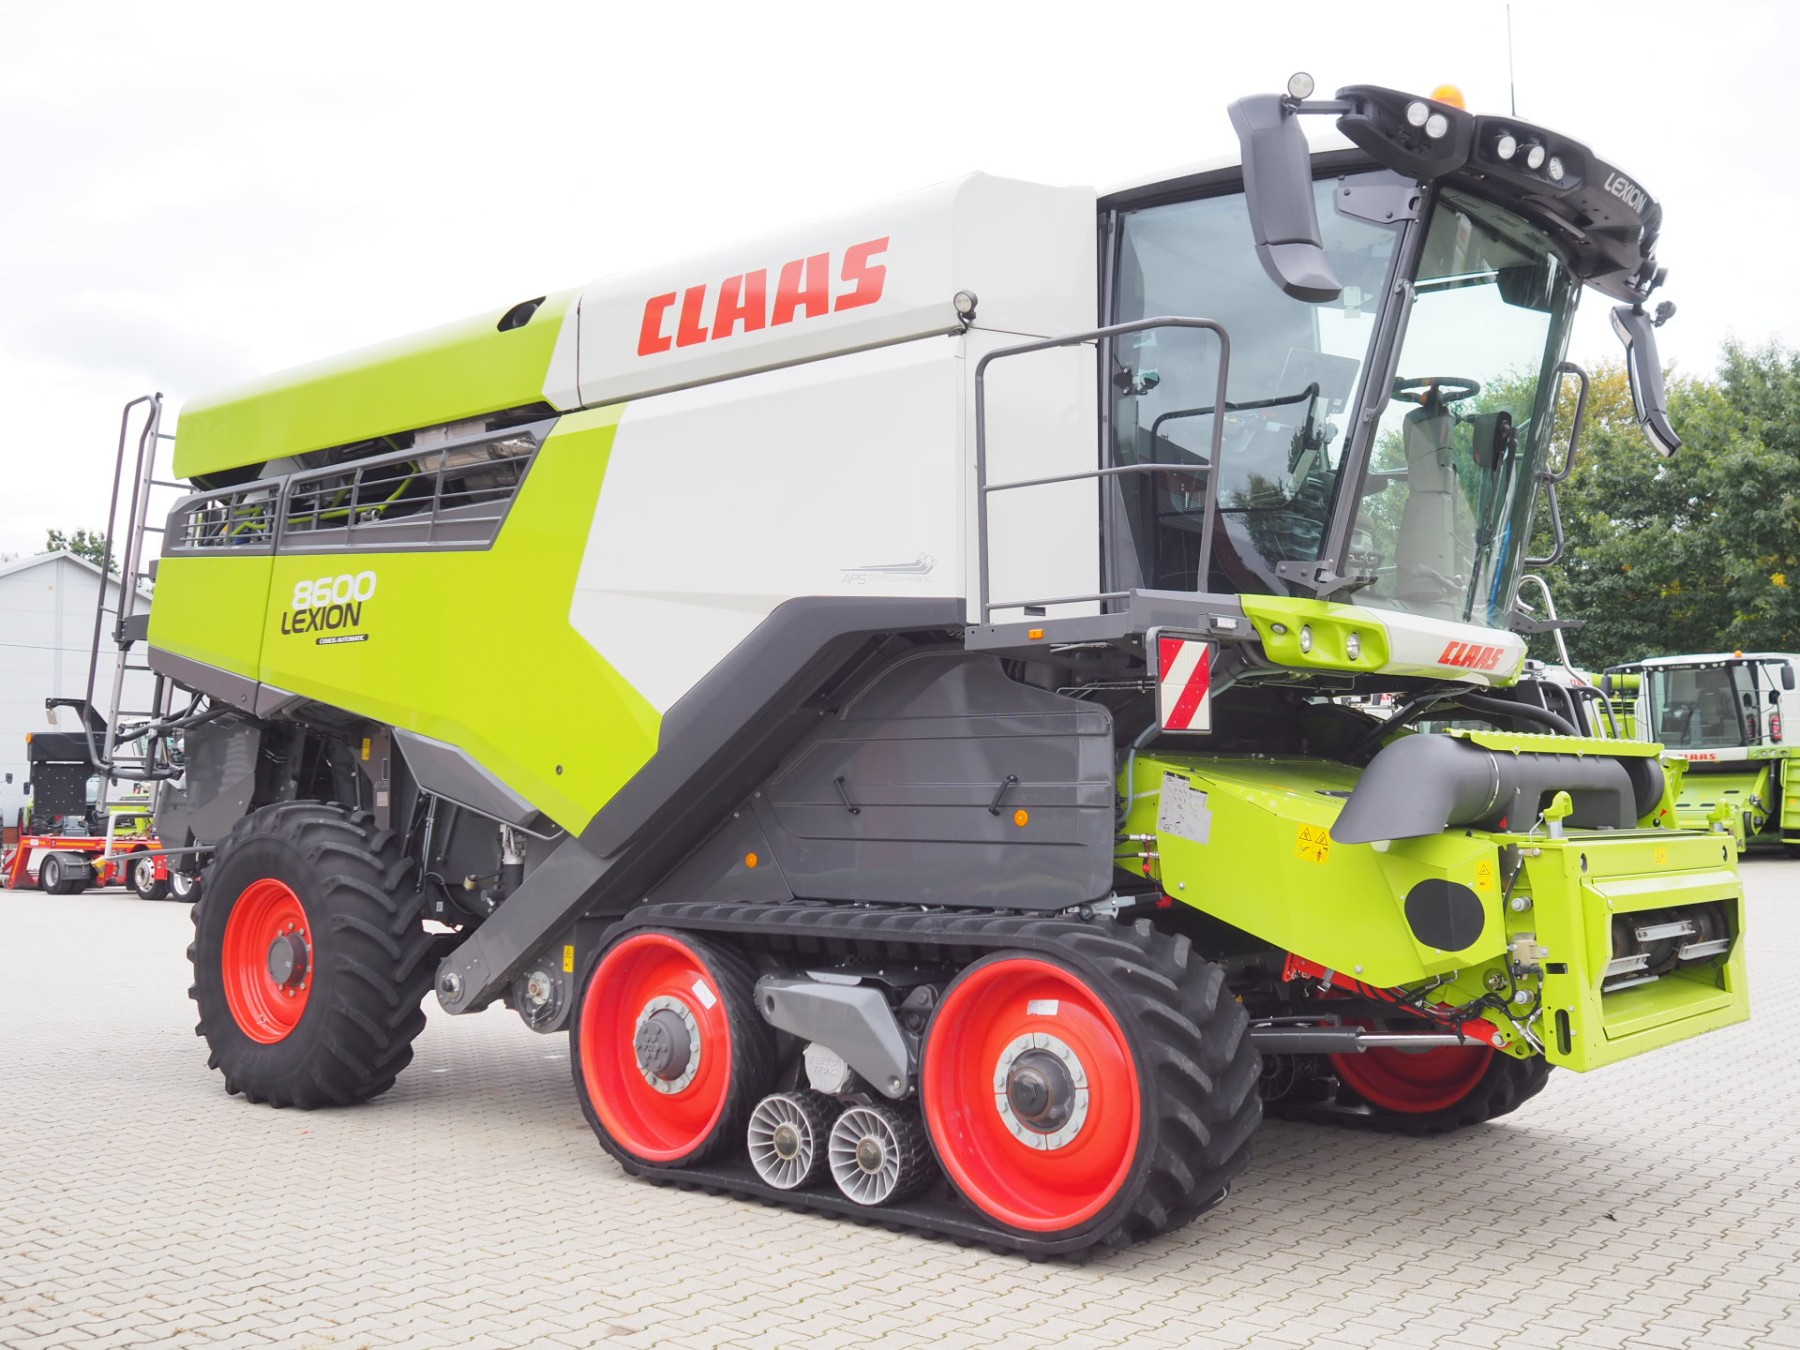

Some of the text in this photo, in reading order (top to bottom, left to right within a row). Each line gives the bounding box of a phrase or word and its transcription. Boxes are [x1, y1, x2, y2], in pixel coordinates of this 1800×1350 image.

[1604, 172, 1647, 214] LEXION
[637, 236, 890, 357] CLAAS
[292, 570, 377, 610] 8600
[841, 573, 867, 585] APS
[281, 601, 362, 635] LEXION
[1437, 641, 1504, 670] CLAAS
